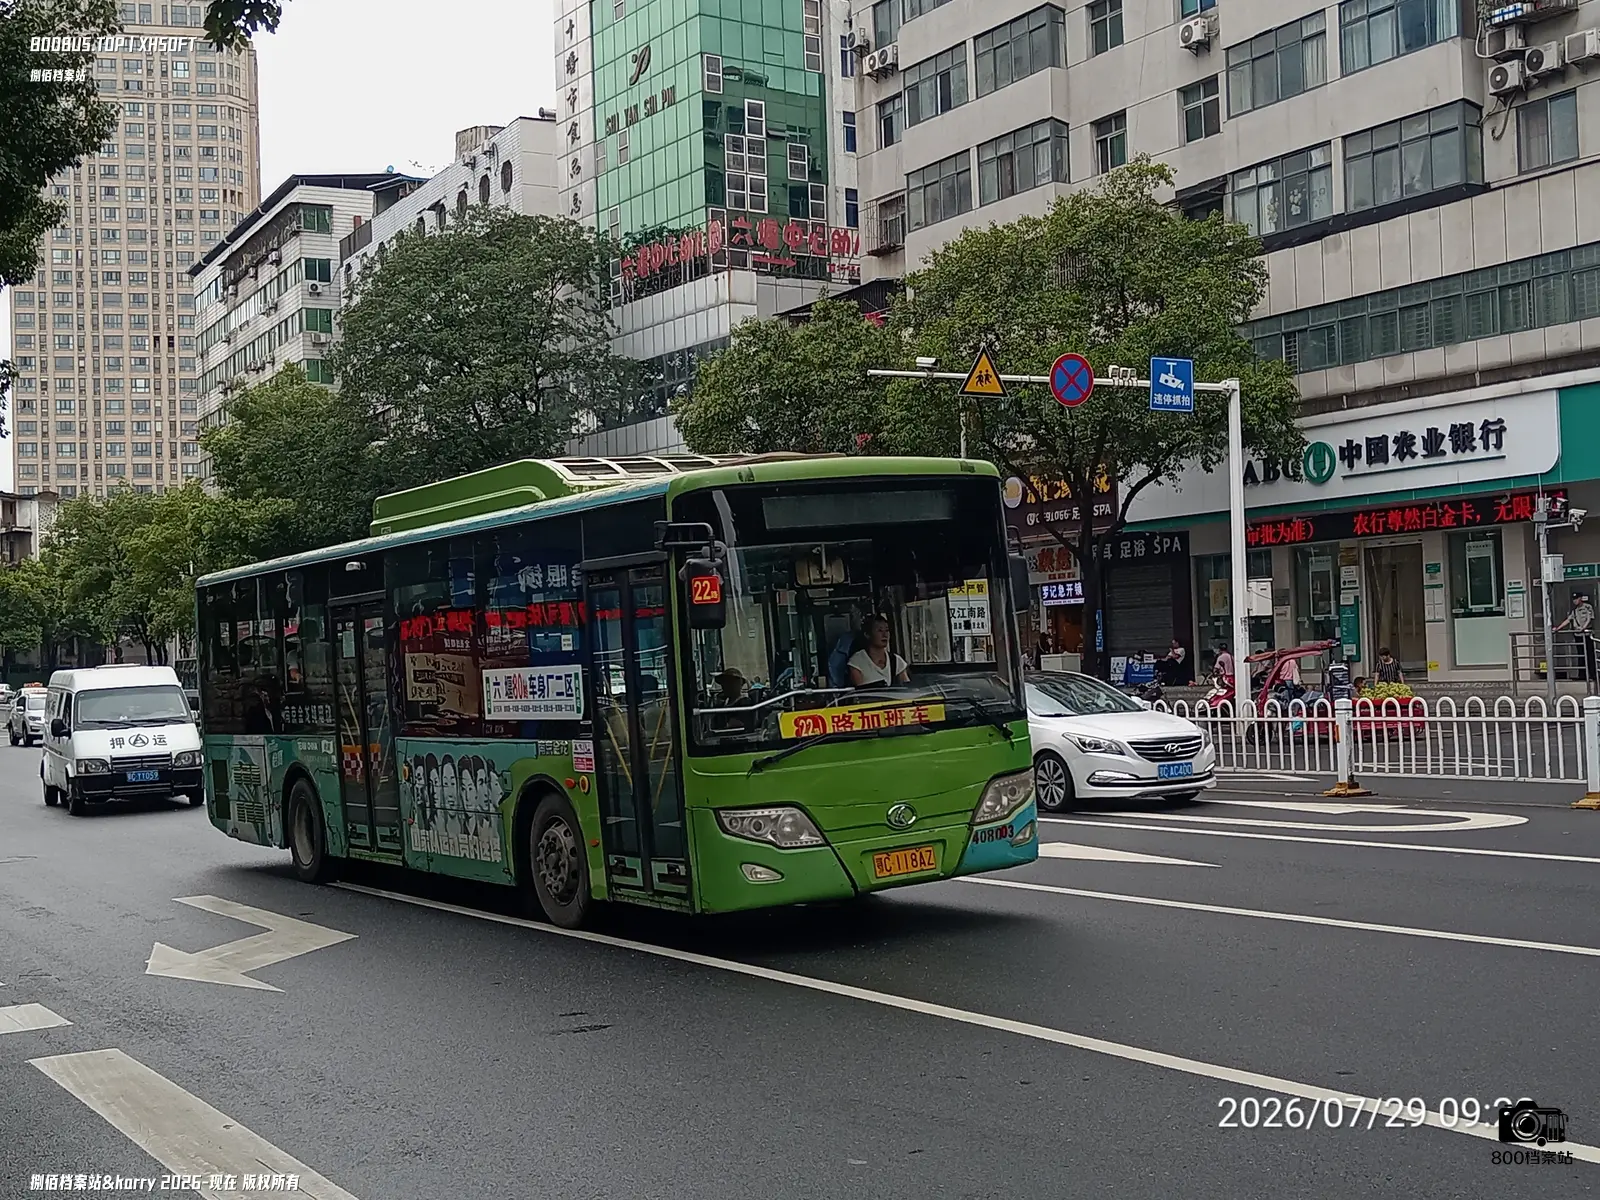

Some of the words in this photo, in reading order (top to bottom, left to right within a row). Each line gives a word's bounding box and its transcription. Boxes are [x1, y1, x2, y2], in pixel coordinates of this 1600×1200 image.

[644, 94, 659, 118] SHI
[1153, 393, 1191, 406] 违停抓拍
[1338, 418, 1507, 470] 中国农业银行
[1093, 503, 1113, 517] SPA
[1353, 491, 1567, 535] 农行尊然白金卡，无限
[1120, 539, 1146, 560] 足浴
[1153, 535, 1182, 555] SPA
[972, 824, 1015, 845] 408003
